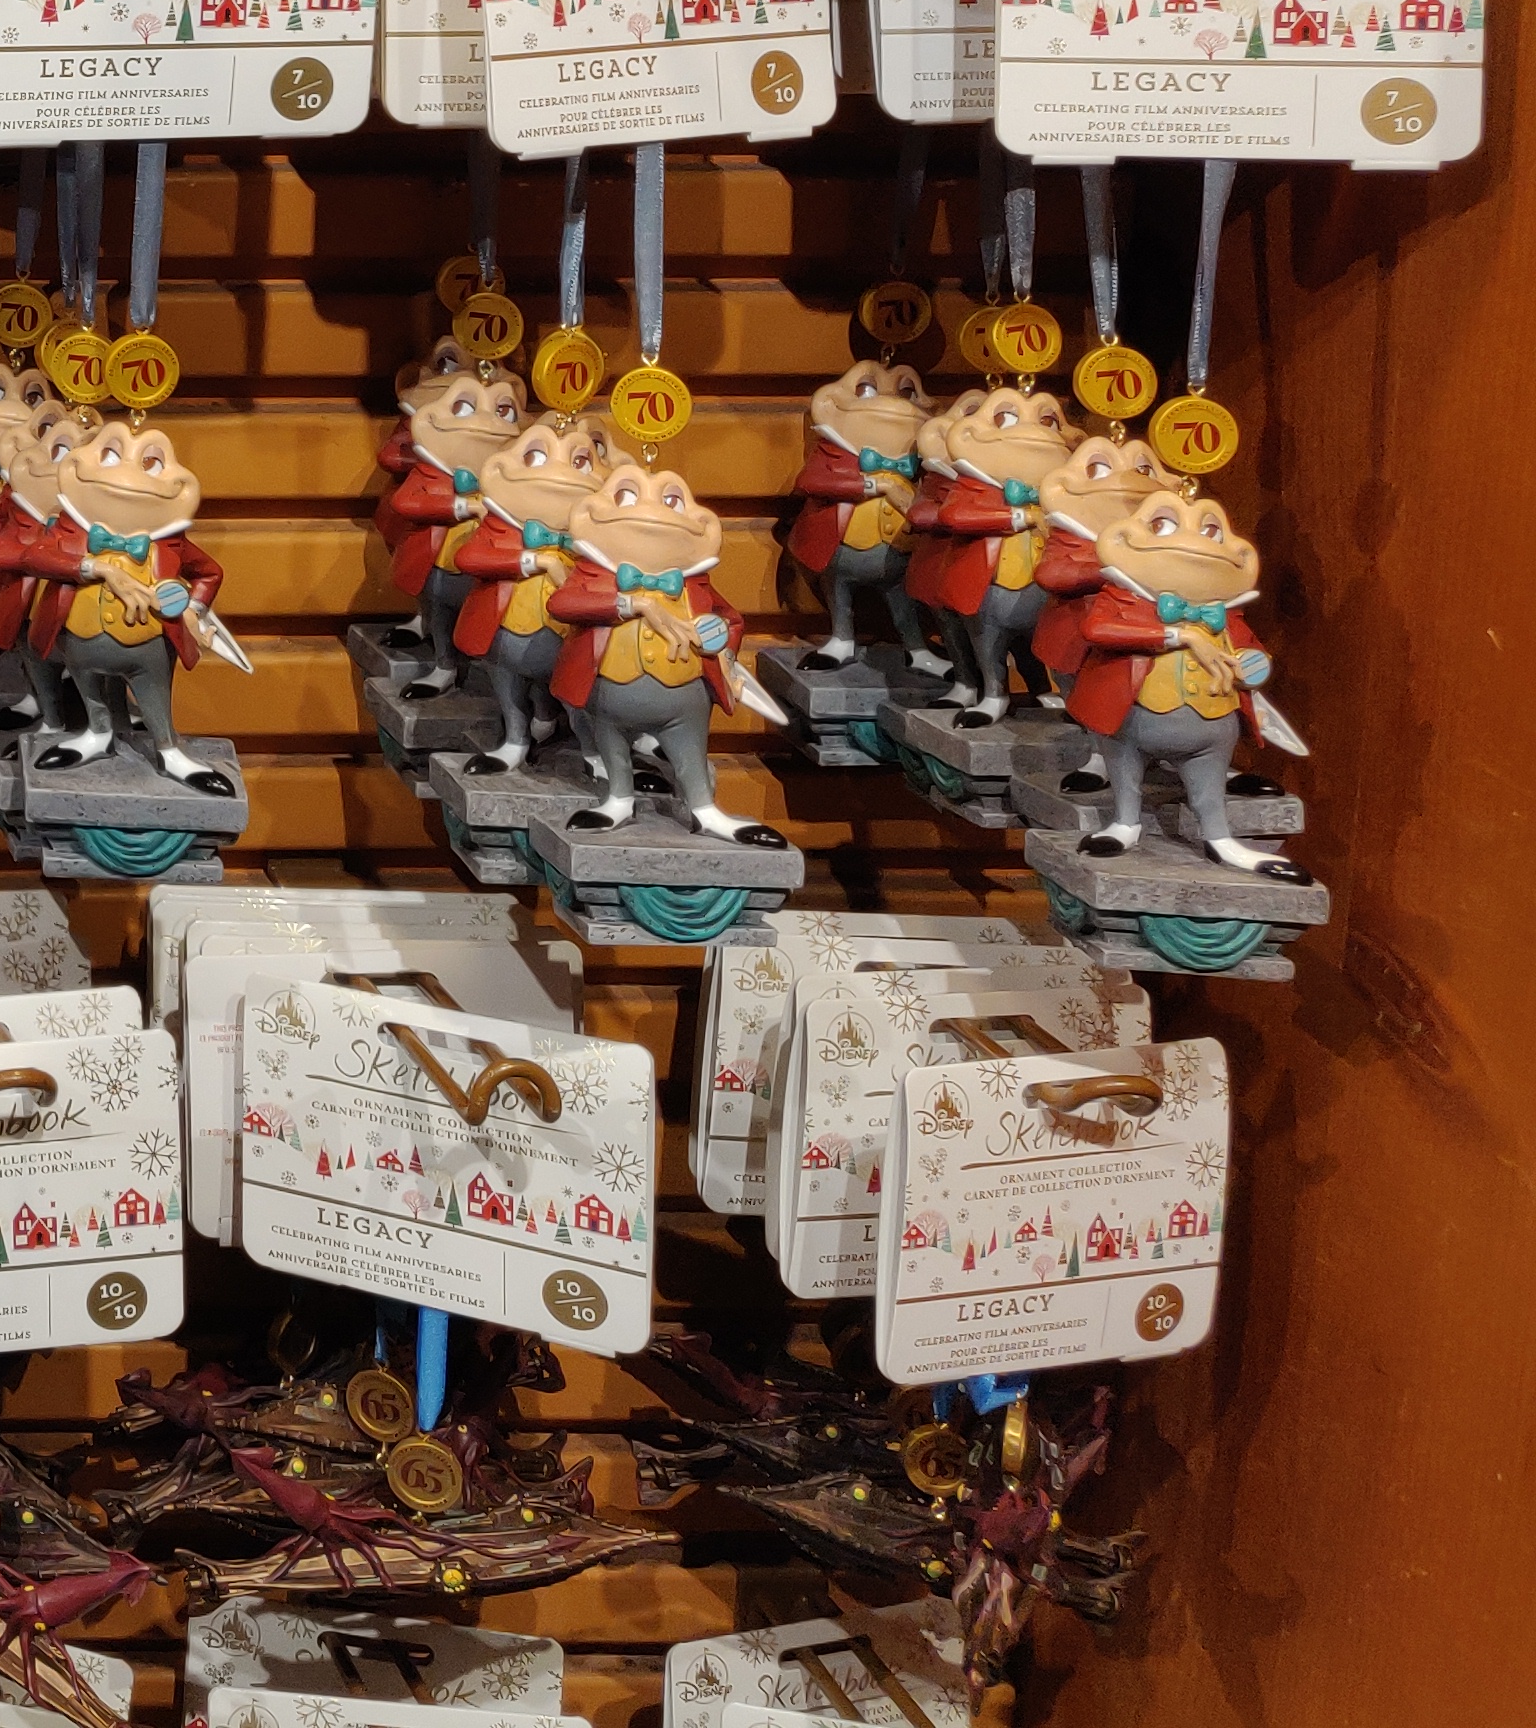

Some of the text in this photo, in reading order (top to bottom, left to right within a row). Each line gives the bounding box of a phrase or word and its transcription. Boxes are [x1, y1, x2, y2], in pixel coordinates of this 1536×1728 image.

[39, 57, 163, 79] LEGACY
[557, 55, 658, 83] LEGACY
[1090, 71, 1231, 93] LEGACY
[121, 358, 166, 389] 70
[627, 393, 675, 425] 70
[1173, 422, 1221, 454] 70
[317, 1207, 434, 1250] LEGACY
[956, 1293, 1055, 1323] LEGACY
[402, 1462, 442, 1493] 65
